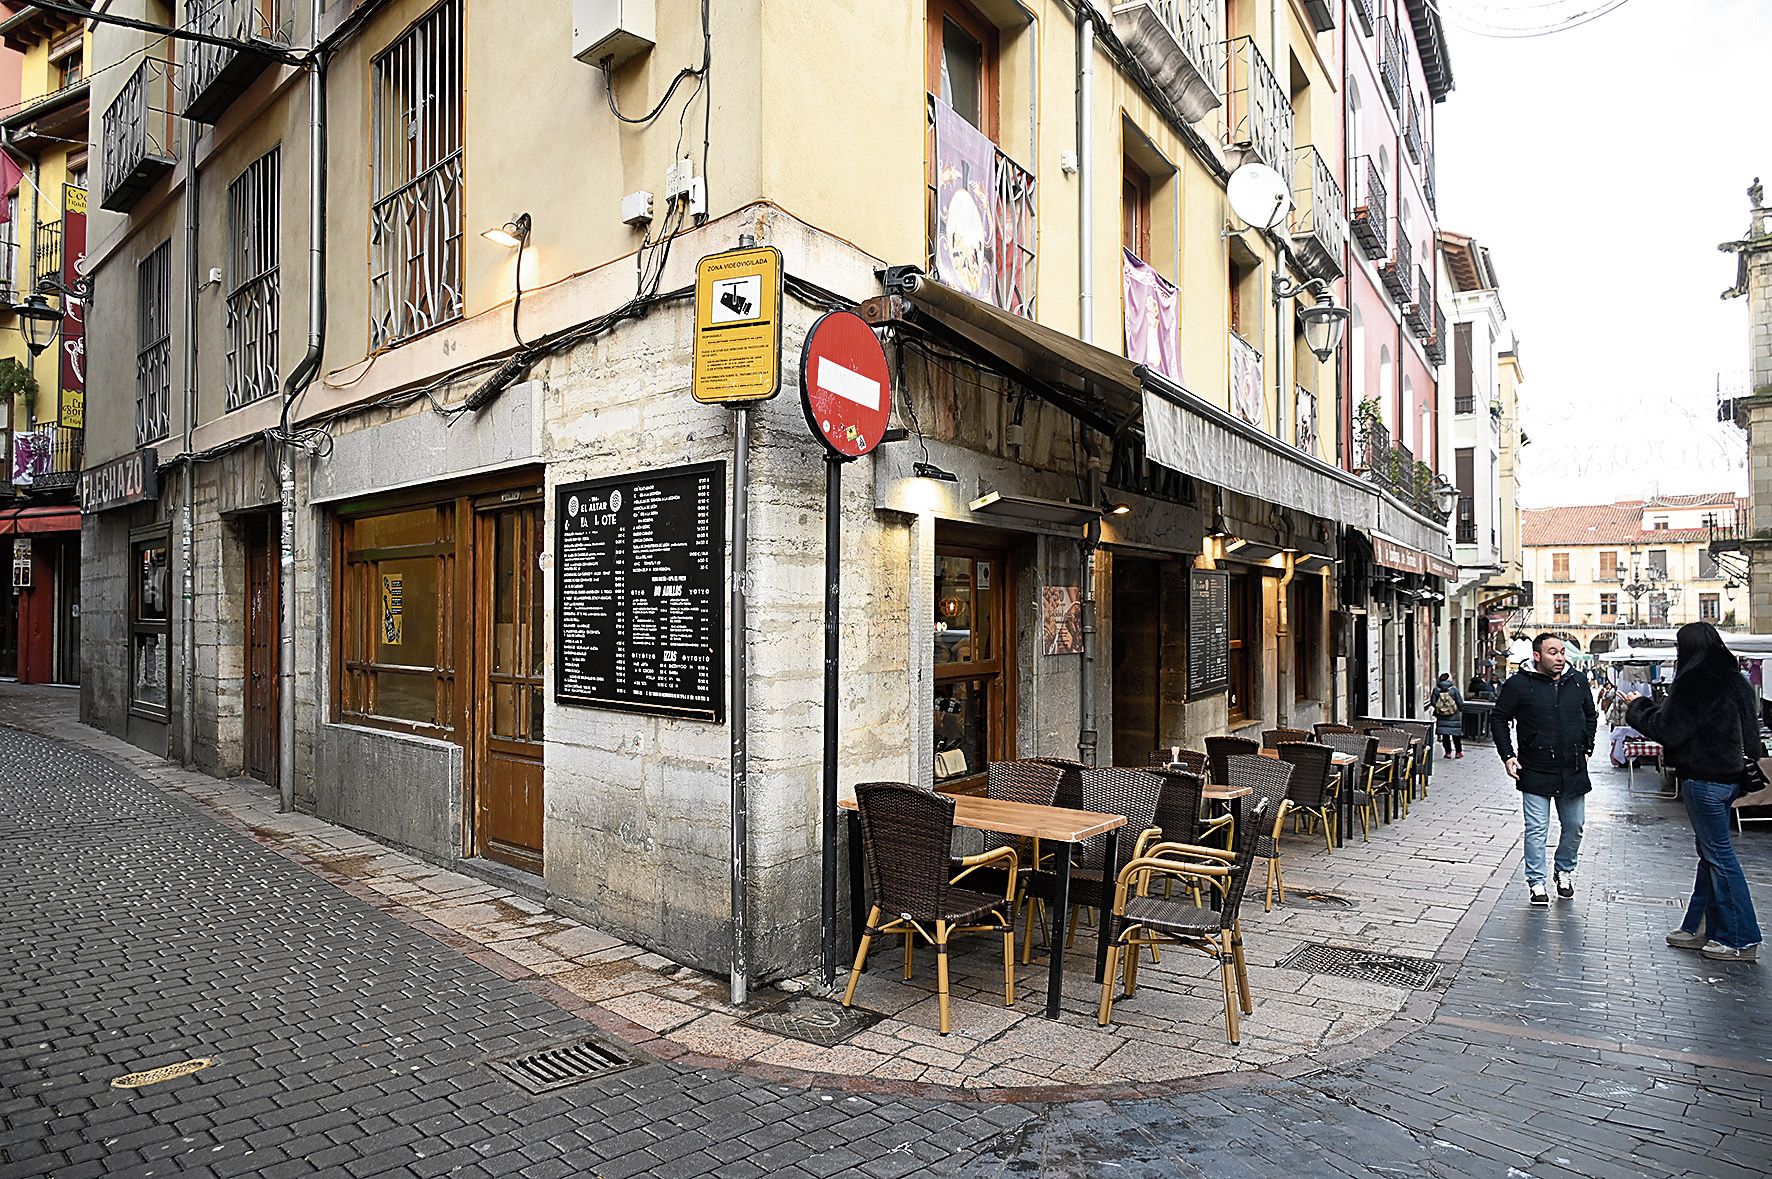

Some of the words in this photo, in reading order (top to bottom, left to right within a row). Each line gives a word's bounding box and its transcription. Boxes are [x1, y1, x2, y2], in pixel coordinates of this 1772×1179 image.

[707, 264, 723, 272] ZONA
[724, 258, 768, 270] VIDEOVIGILADA
[82, 456, 143, 508] FLECHAZO
[580, 503, 588, 513] EL
[588, 501, 608, 512] ALTAR
